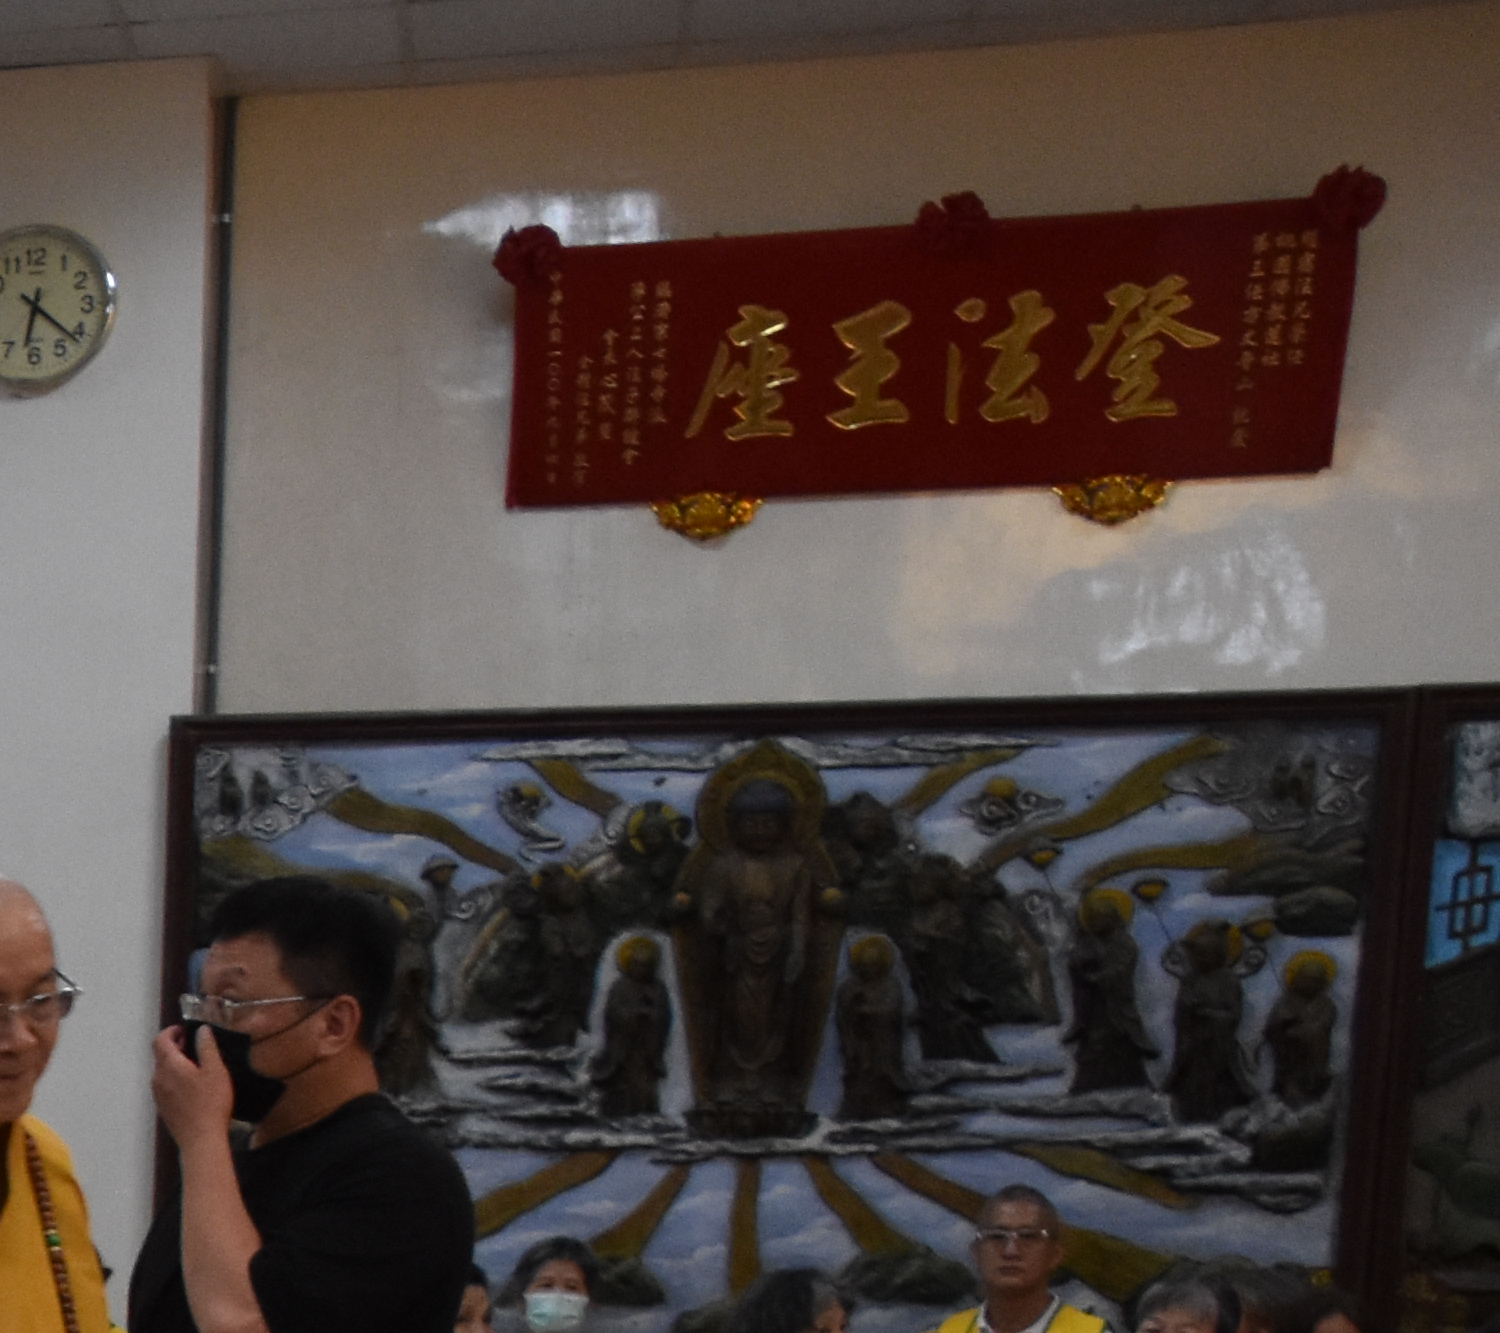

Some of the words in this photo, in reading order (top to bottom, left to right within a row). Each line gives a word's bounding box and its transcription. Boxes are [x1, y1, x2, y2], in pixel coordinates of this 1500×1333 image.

[4, 256, 22, 275] 11
[26, 247, 46, 267] 12
[60, 254, 68, 272] 1
[73, 271, 88, 290] 2
[80, 295, 95, 313] 3
[73, 321, 86, 340] 4
[2, 340, 15, 358] 7
[27, 346, 41, 365] 6
[53, 339, 67, 357] 5
[684, 274, 1221, 443] 登法王座
